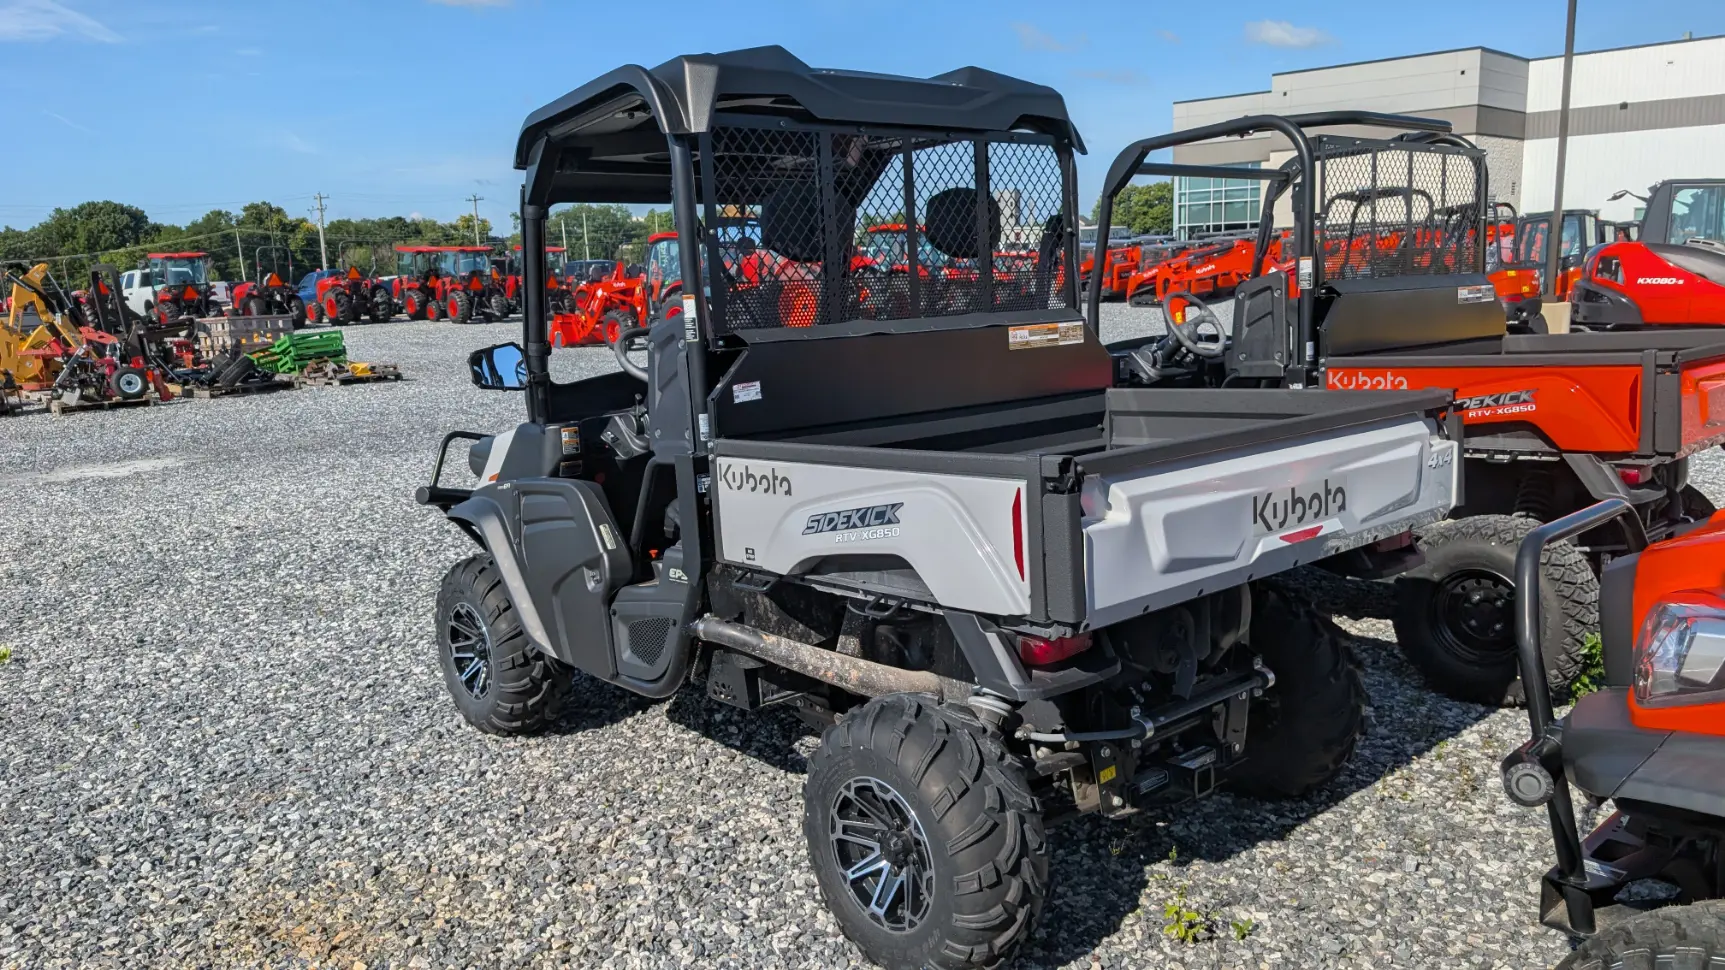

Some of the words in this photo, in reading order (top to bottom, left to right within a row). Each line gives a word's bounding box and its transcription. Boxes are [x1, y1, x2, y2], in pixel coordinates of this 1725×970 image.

[1427, 448, 1453, 469] 4x4
[718, 463, 792, 496] Kubota
[802, 502, 904, 535] SIDEKICK
[1253, 478, 1346, 532] Kubota
[835, 527, 900, 543] RTV-XG850
